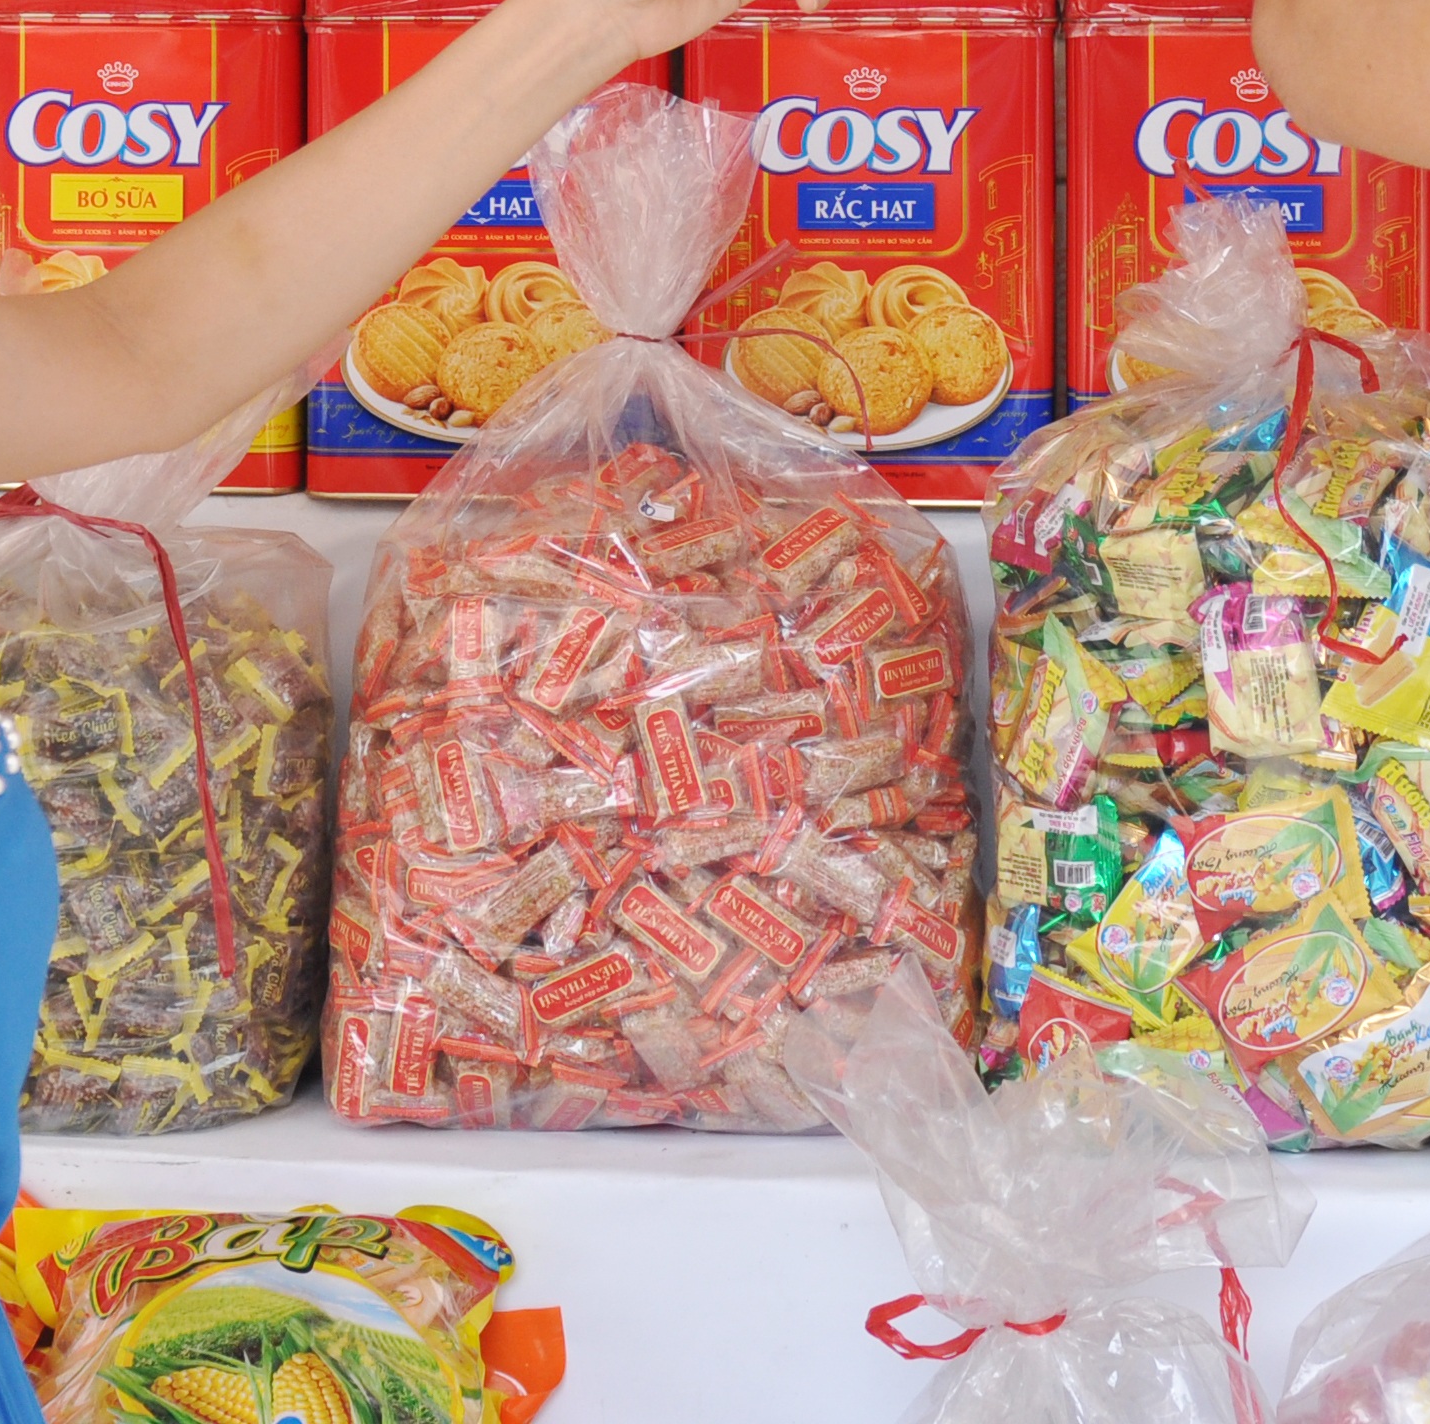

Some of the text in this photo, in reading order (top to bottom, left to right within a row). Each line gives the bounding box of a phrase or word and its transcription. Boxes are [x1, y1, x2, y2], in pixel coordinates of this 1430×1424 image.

[4, 88, 231, 168] COSY
[758, 94, 981, 176] COSY
[115, 186, 157, 209] SỮA
[489, 196, 535, 219] HẠT
[815, 190, 916, 222] RẮC HẠT
